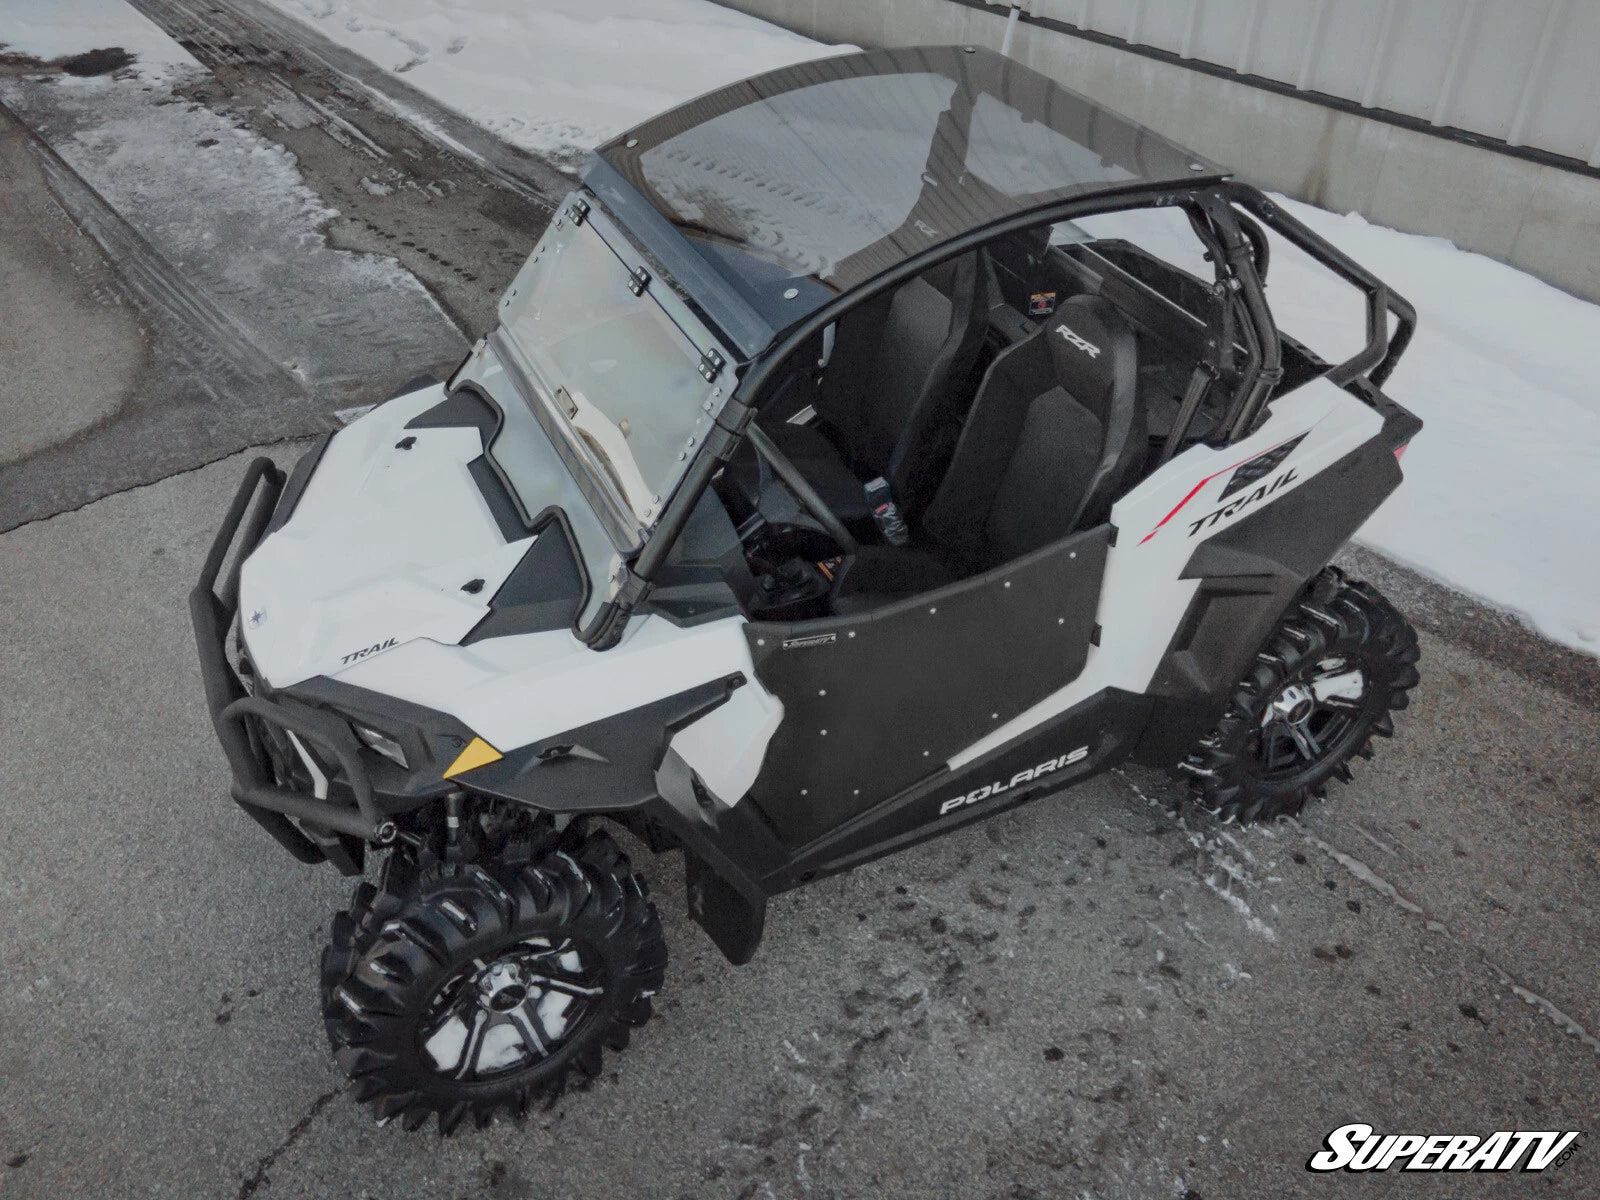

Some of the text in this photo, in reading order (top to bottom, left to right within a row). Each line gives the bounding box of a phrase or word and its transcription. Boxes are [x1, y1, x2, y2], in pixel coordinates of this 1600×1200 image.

[1055, 324, 1100, 358] RZR
[1188, 466, 1299, 537] TRAIL
[341, 637, 400, 664] TRAIL
[940, 745, 1088, 815] POLARIS
